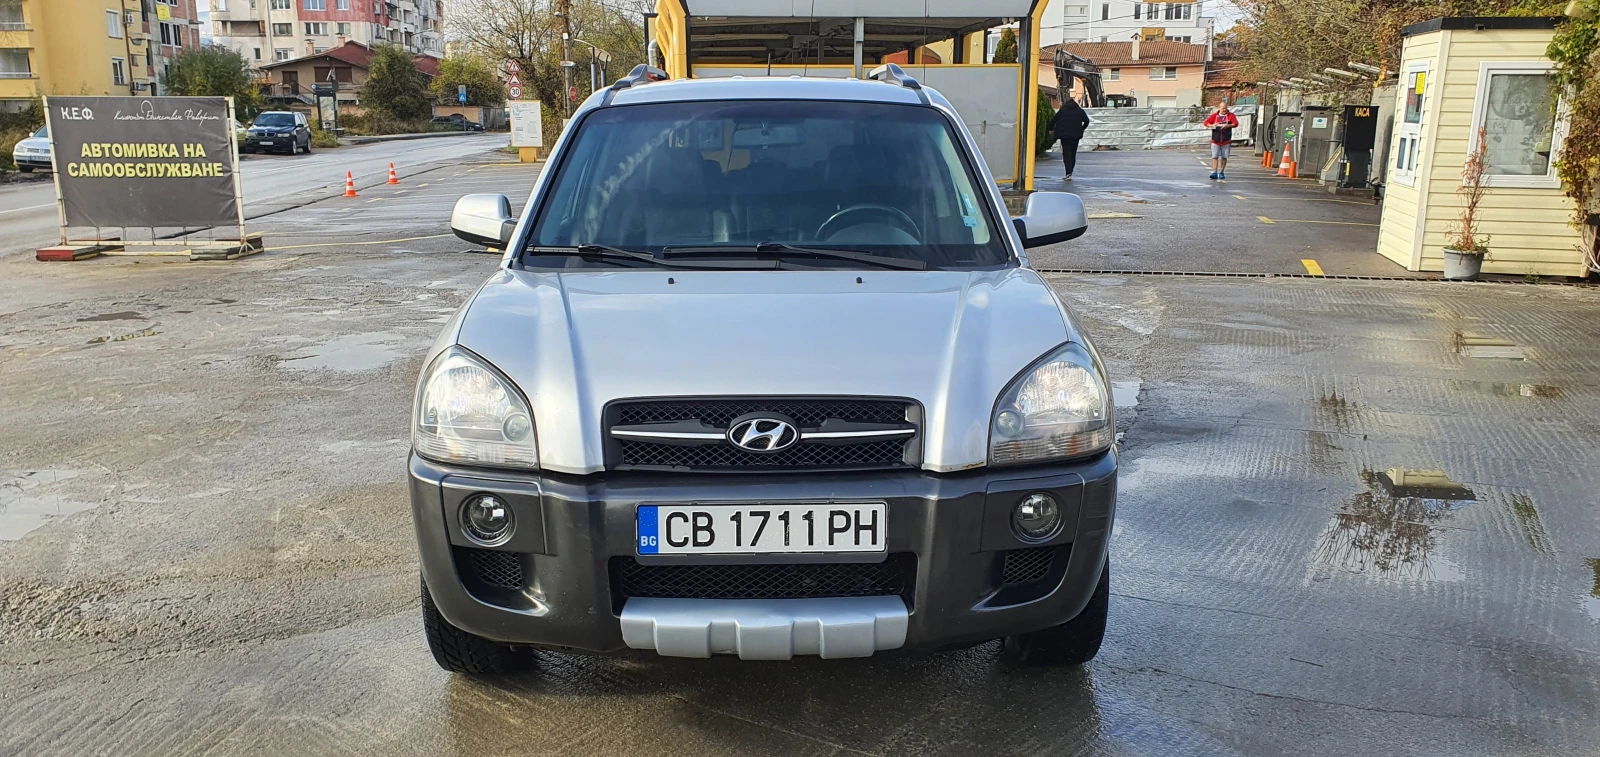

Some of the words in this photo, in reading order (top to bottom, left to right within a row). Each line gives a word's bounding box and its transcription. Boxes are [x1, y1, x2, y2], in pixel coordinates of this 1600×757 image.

[511, 88, 520, 96] 30
[60, 106, 95, 120] К.Е.Ф.
[184, 108, 220, 127] Фаворит
[1354, 107, 1371, 118] КАСА
[80, 142, 180, 158] АВТОМИВКА
[183, 143, 207, 158] НА
[67, 162, 224, 178] САМООБСЛУЖВАНЕ
[665, 511, 716, 548] CB
[729, 510, 815, 547] 1711
[828, 509, 878, 546] PH
[640, 535, 657, 547] BG
